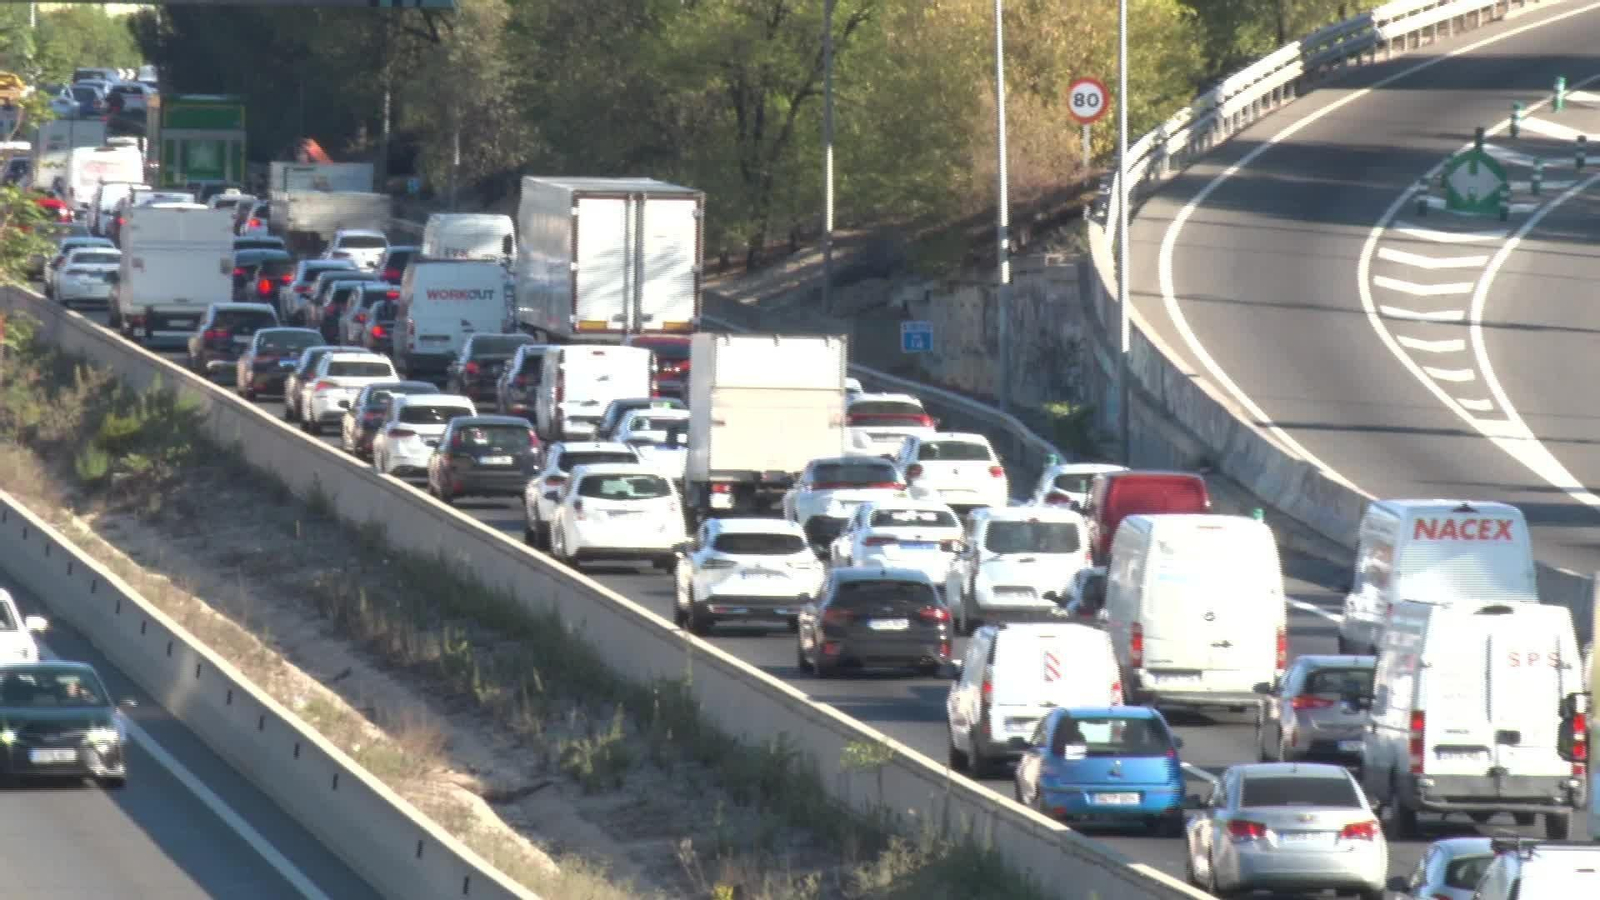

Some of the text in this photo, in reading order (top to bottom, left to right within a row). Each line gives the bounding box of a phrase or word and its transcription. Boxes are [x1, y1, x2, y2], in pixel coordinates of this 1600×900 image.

[1073, 92, 1100, 107] 80
[426, 289, 495, 301] WORKOUT
[1413, 518, 1514, 540] NACEX
